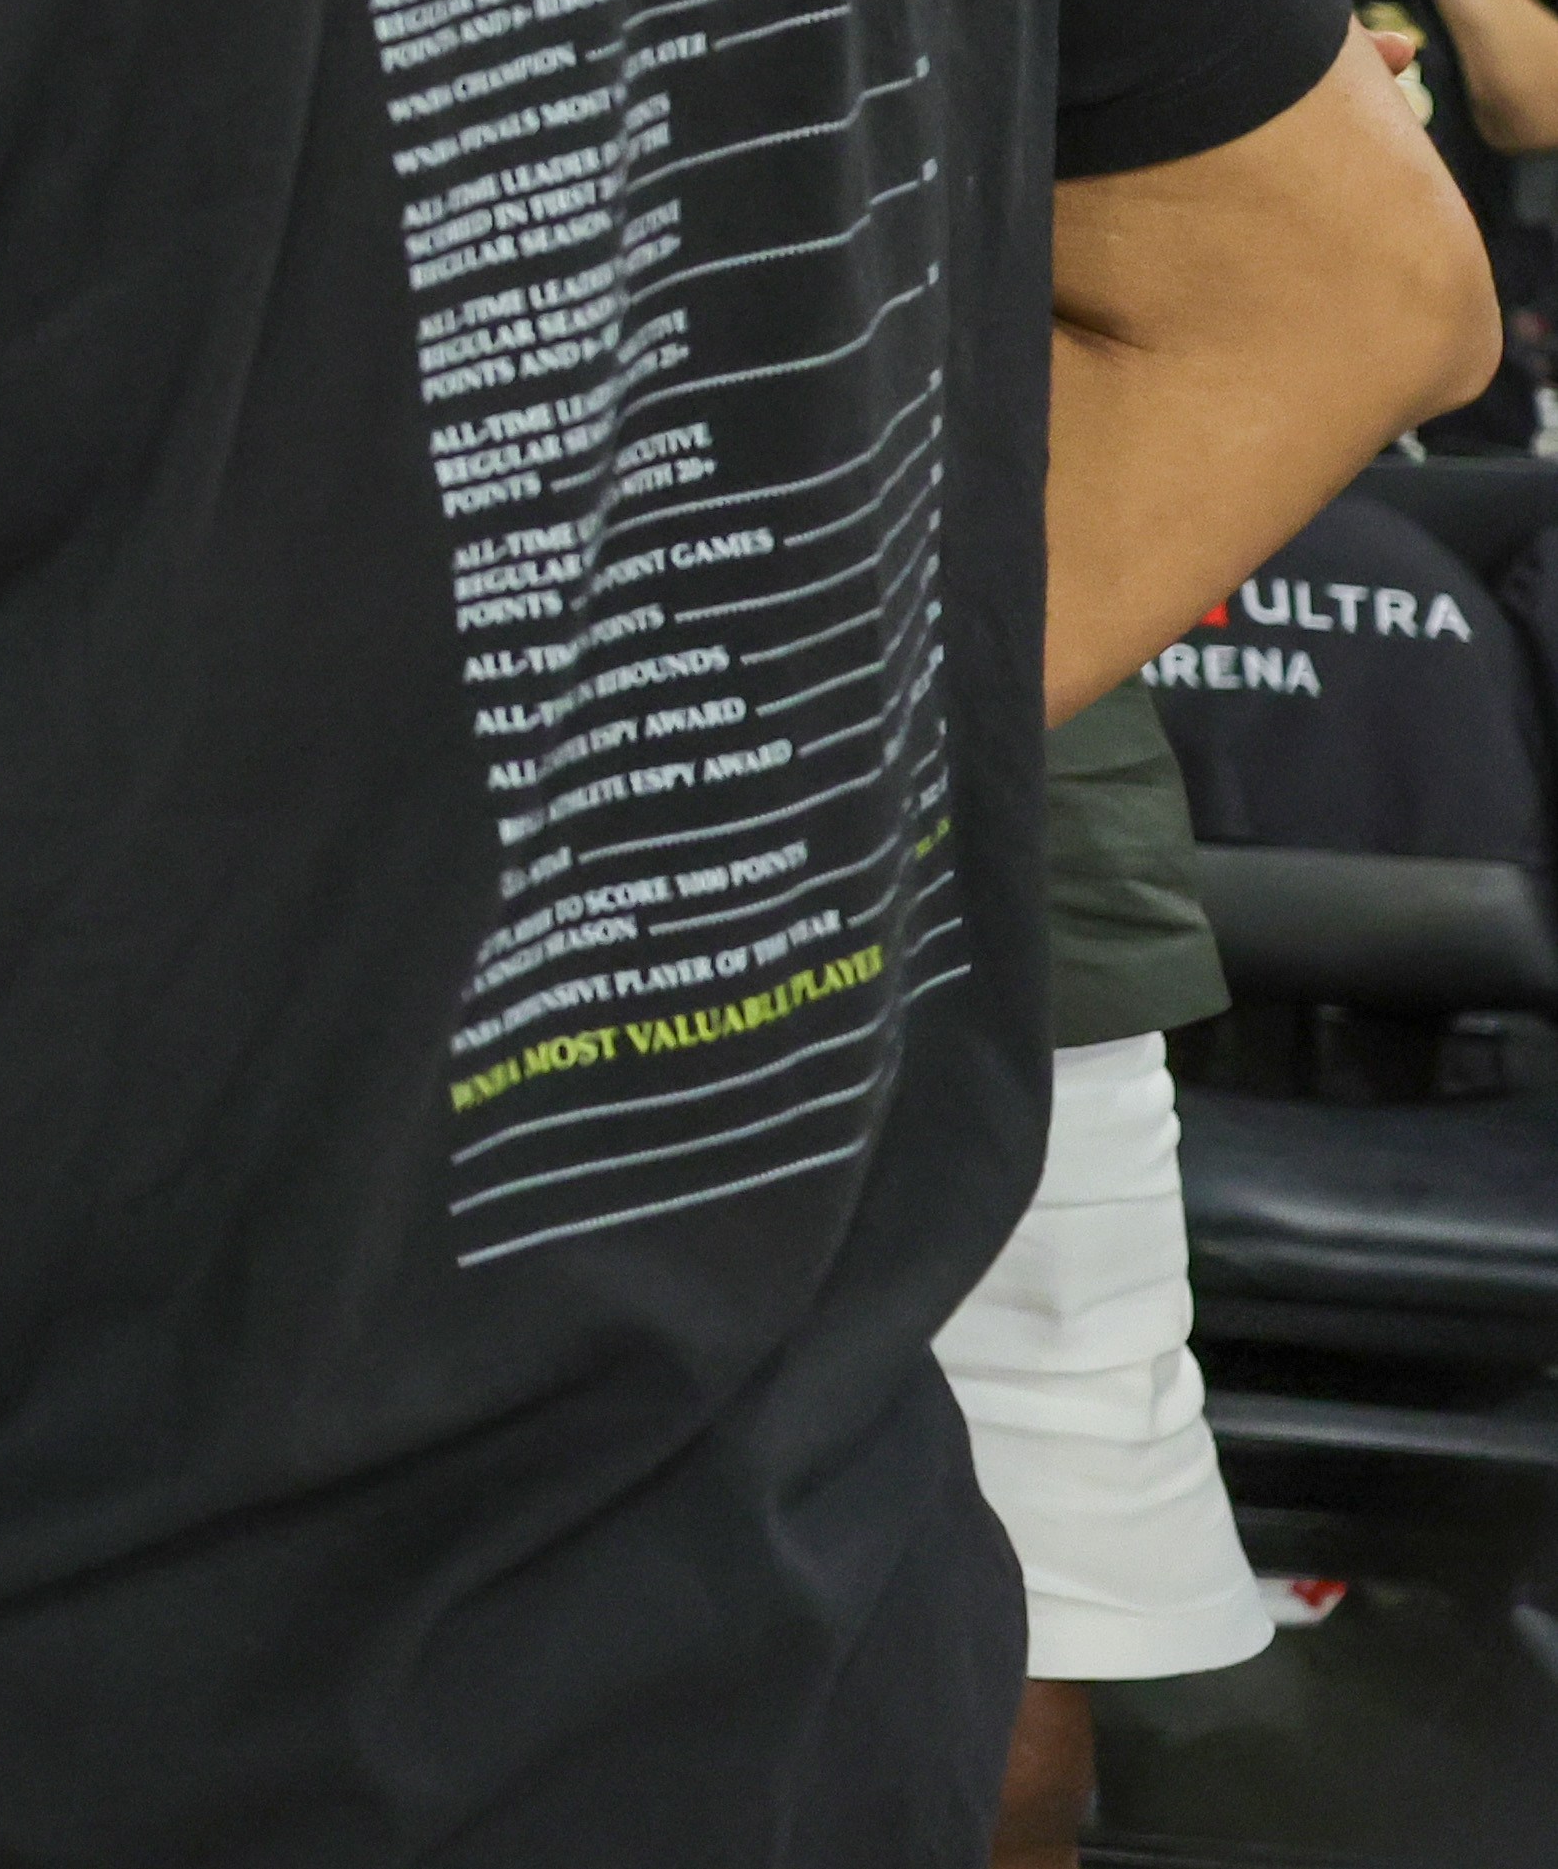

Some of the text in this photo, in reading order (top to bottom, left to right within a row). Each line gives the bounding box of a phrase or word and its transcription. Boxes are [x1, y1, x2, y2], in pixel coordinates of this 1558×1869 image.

[670, 526, 777, 571] GAMES
[1239, 578, 1474, 643] ULTRA
[522, 1027, 621, 1080] MOST
